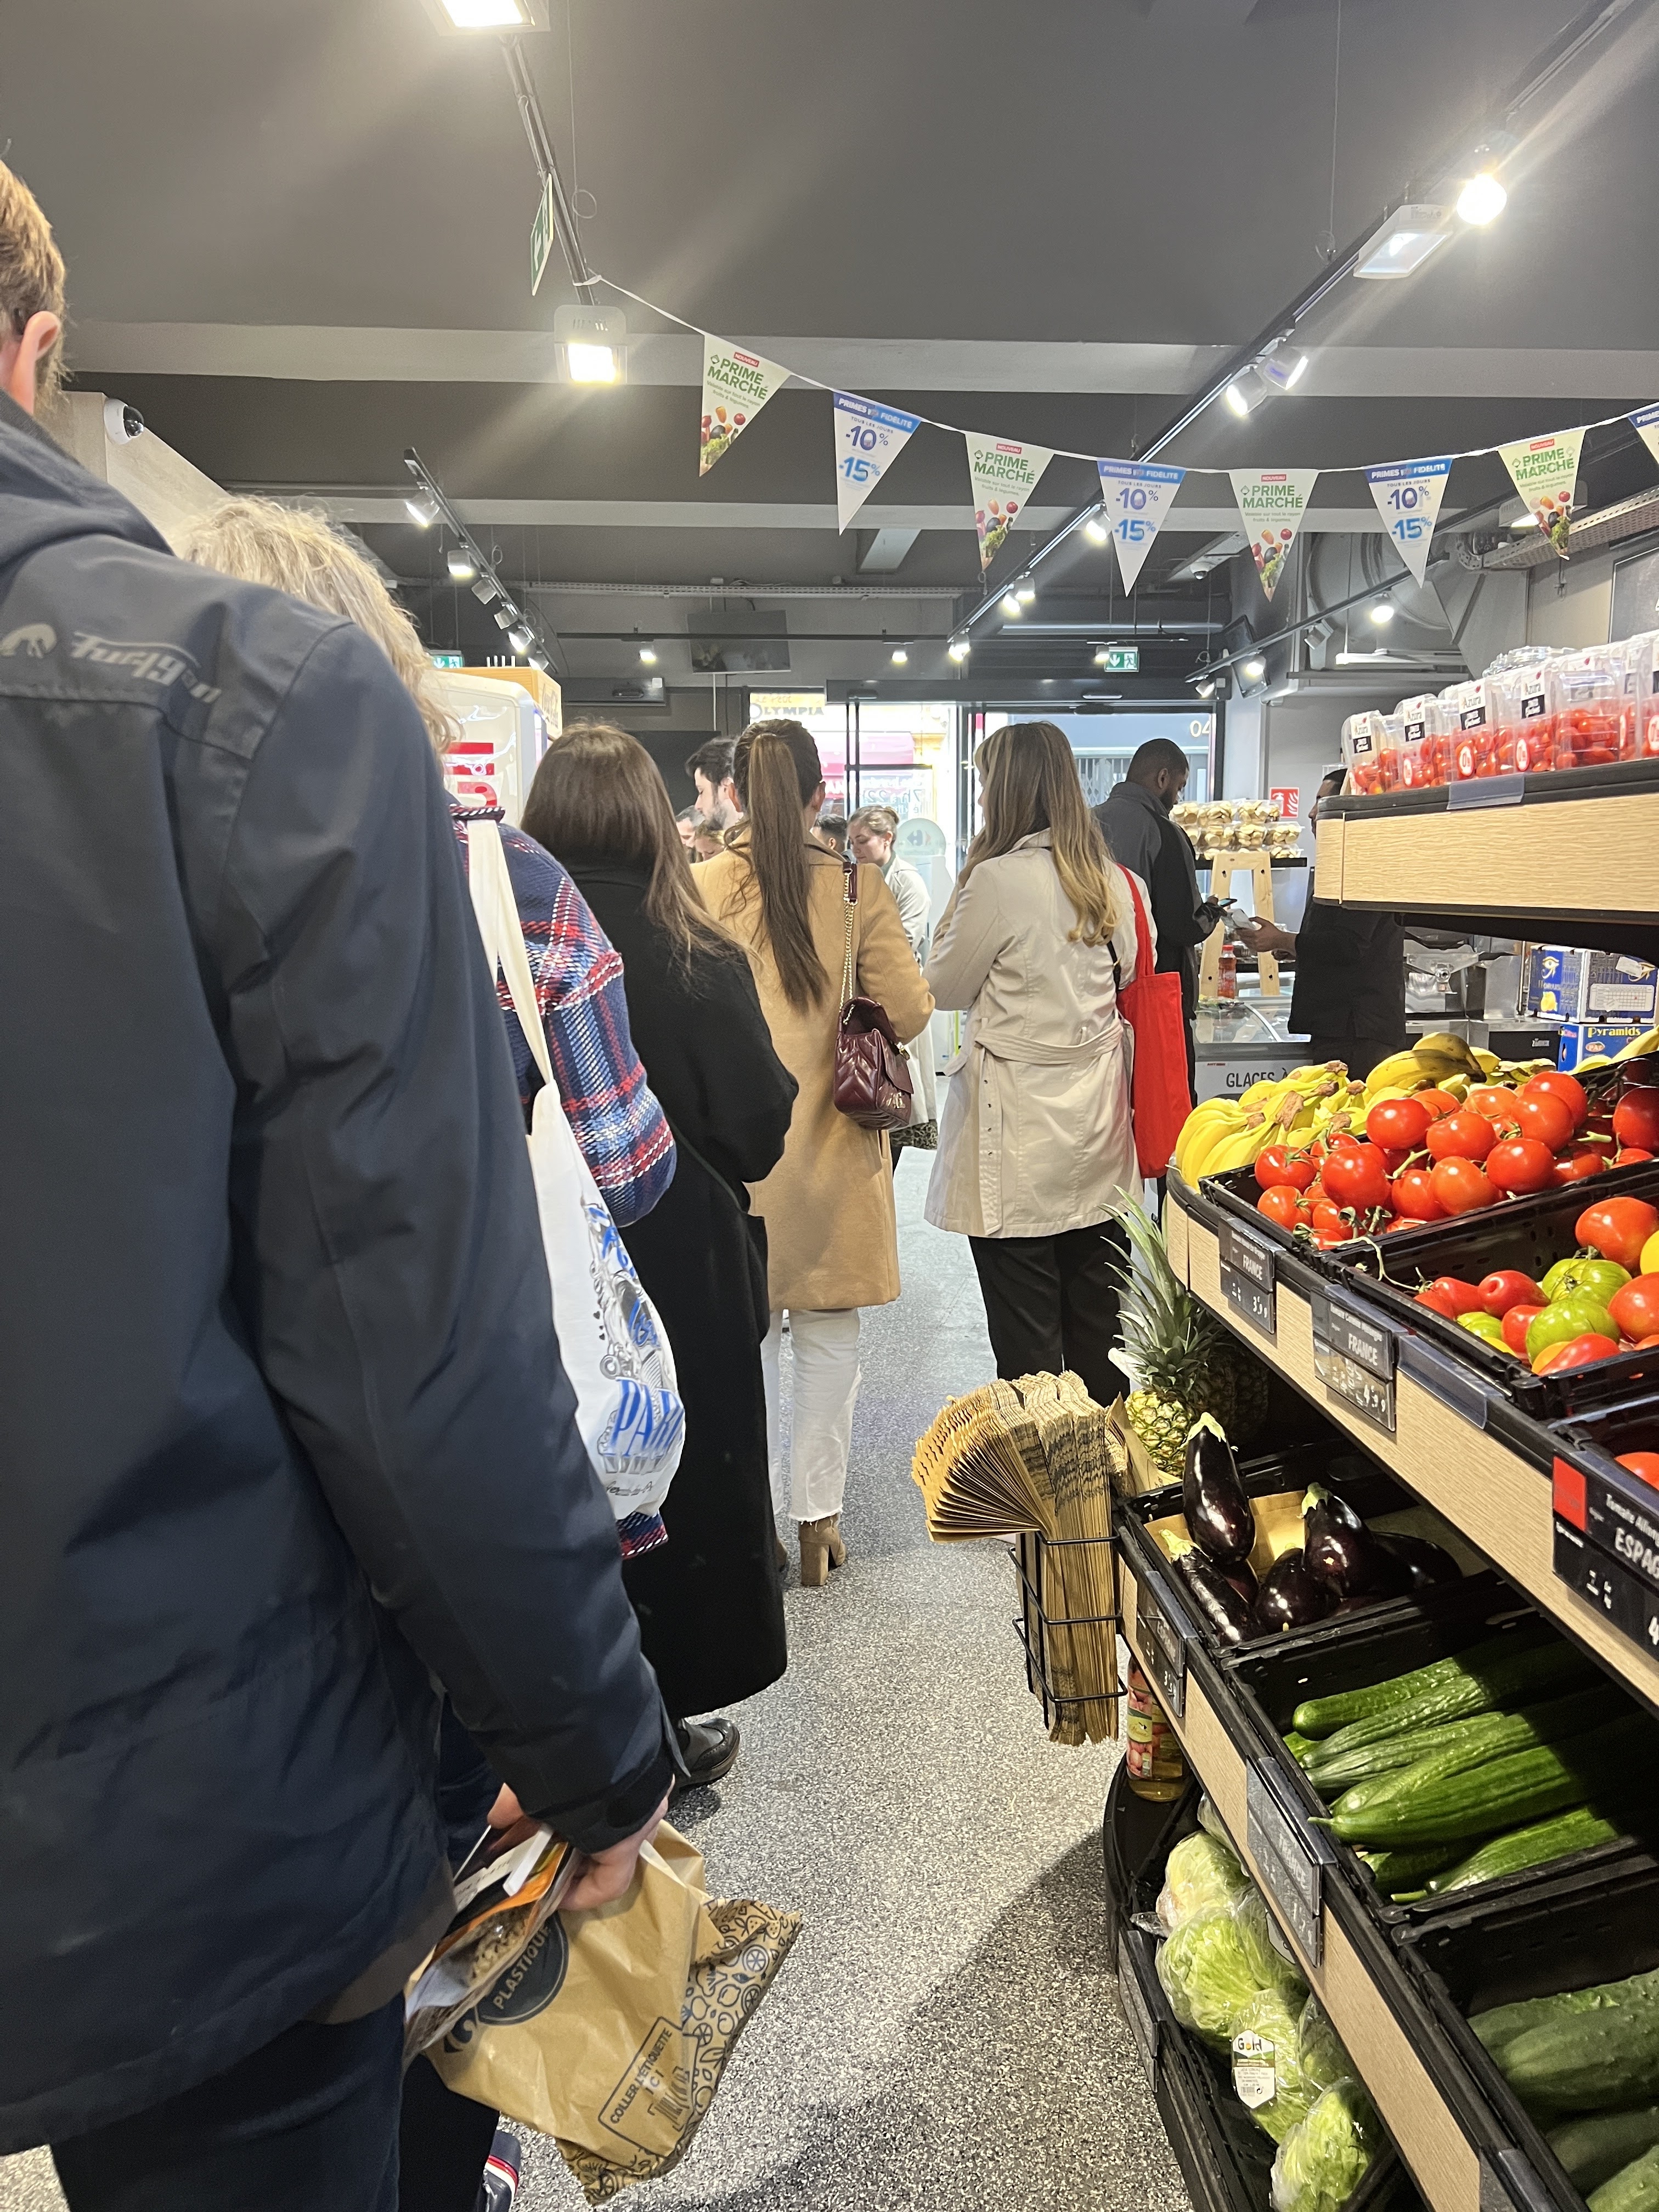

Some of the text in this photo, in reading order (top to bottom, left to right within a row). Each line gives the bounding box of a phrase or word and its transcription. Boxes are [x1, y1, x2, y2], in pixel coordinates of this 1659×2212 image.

[720, 358, 764, 385] PRIME
[707, 366, 768, 400] MARCHÉ
[838, 398, 867, 413] PRIMES
[846, 425, 889, 451] -10%
[985, 452, 1028, 470] PRIME
[1522, 448, 1565, 467] PRIME
[974, 461, 1035, 484] MARCHÉ
[1103, 466, 1132, 475] PRIMES
[1372, 469, 1400, 479] PRIMES
[1116, 488, 1158, 510] -10%
[1252, 485, 1295, 496] PRIME
[1387, 486, 1429, 510] -10%
[1243, 494, 1303, 508] MARCHÉ
[750, 703, 825, 720] OLYMPIA
[1462, 696, 1481, 709] Azura
[1588, 1027, 1641, 1038] Pyramids
[1243, 1254, 1262, 1280] FRANCE
[1348, 1333, 1378, 1366] FRANCE
[646, 2069, 664, 2095] ICI
[610, 2084, 639, 2124] COLLER
